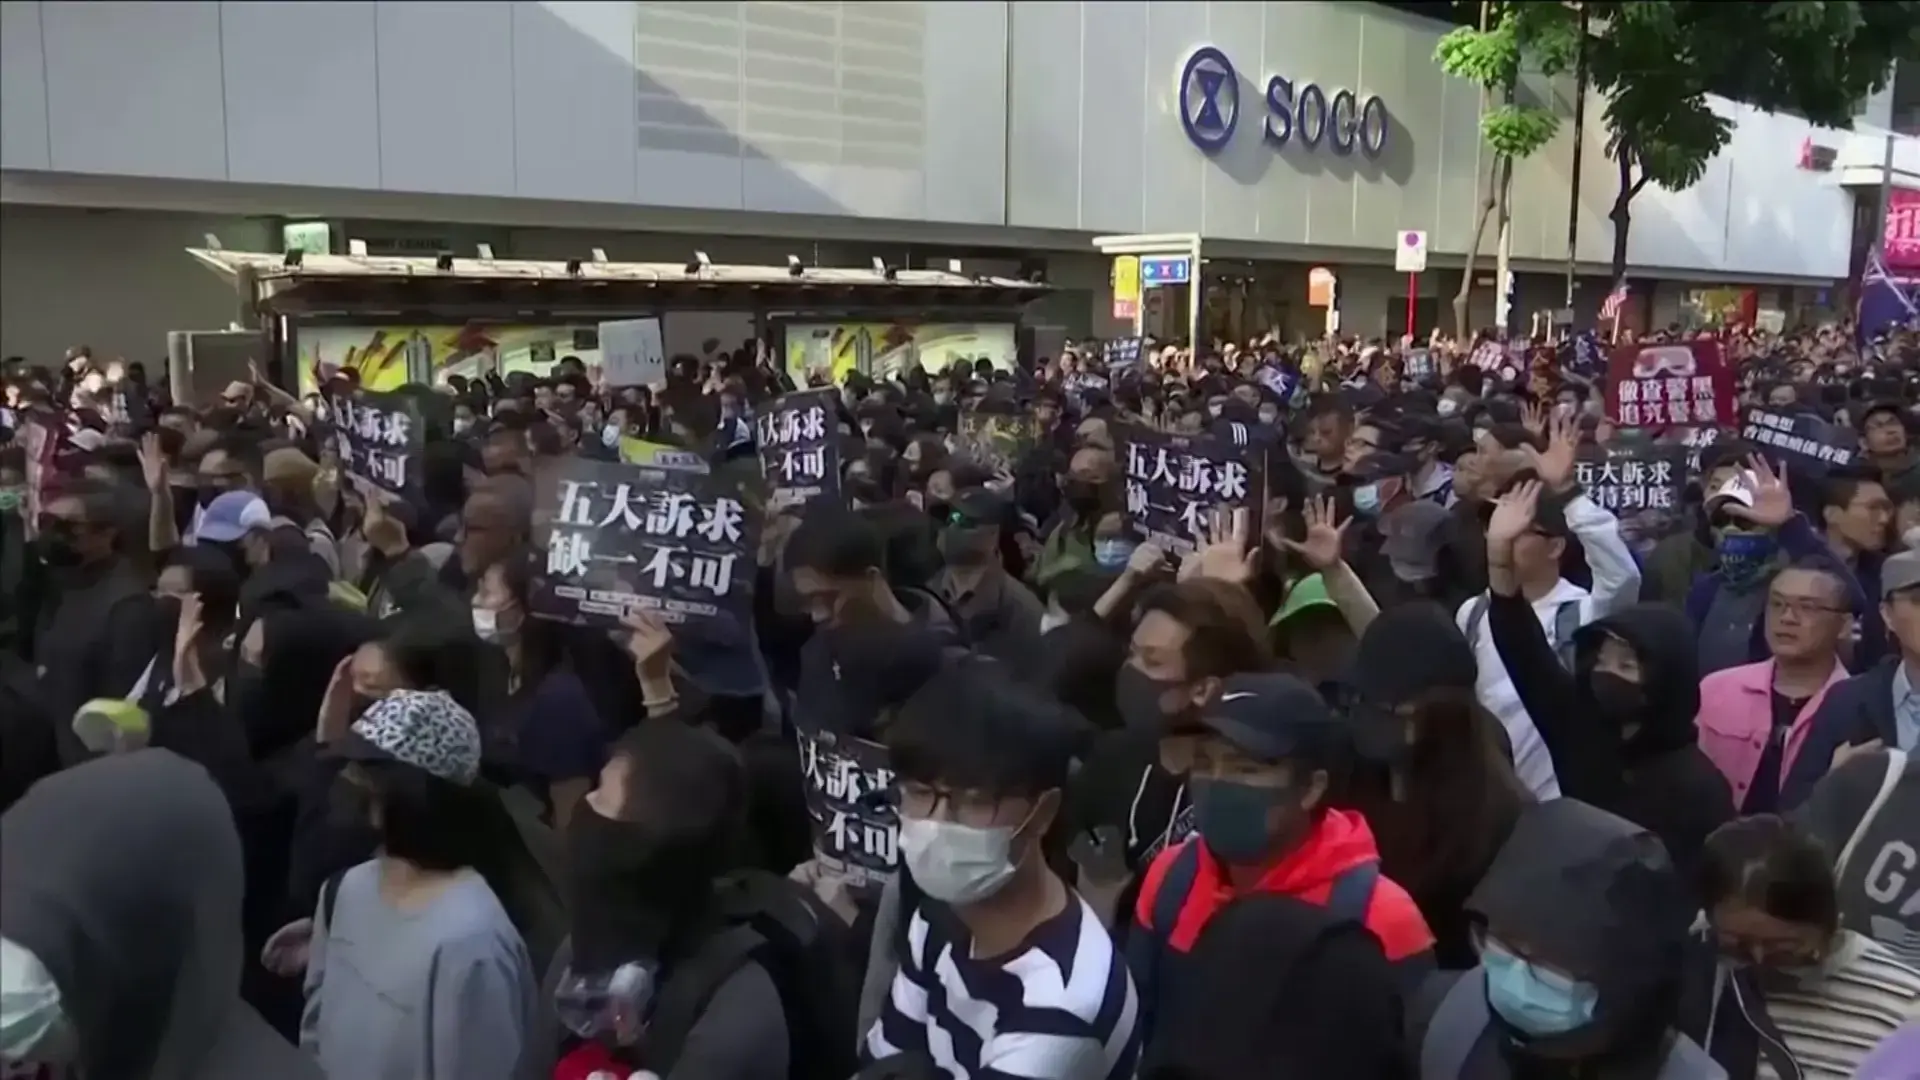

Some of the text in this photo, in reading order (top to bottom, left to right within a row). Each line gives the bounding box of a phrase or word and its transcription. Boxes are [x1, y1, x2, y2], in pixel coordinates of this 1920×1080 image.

[1264, 75, 1387, 157] SOGO
[757, 406, 824, 447] 五大訴求
[1126, 441, 1247, 499] 五大訴求
[1576, 460, 1671, 485] 五大訴求
[1586, 487, 1672, 509] 持到底
[552, 479, 745, 543] 五大訴求
[1126, 478, 1216, 534] 缺一不
[547, 529, 741, 596] 缺一不可
[1864, 840, 1920, 916] G
